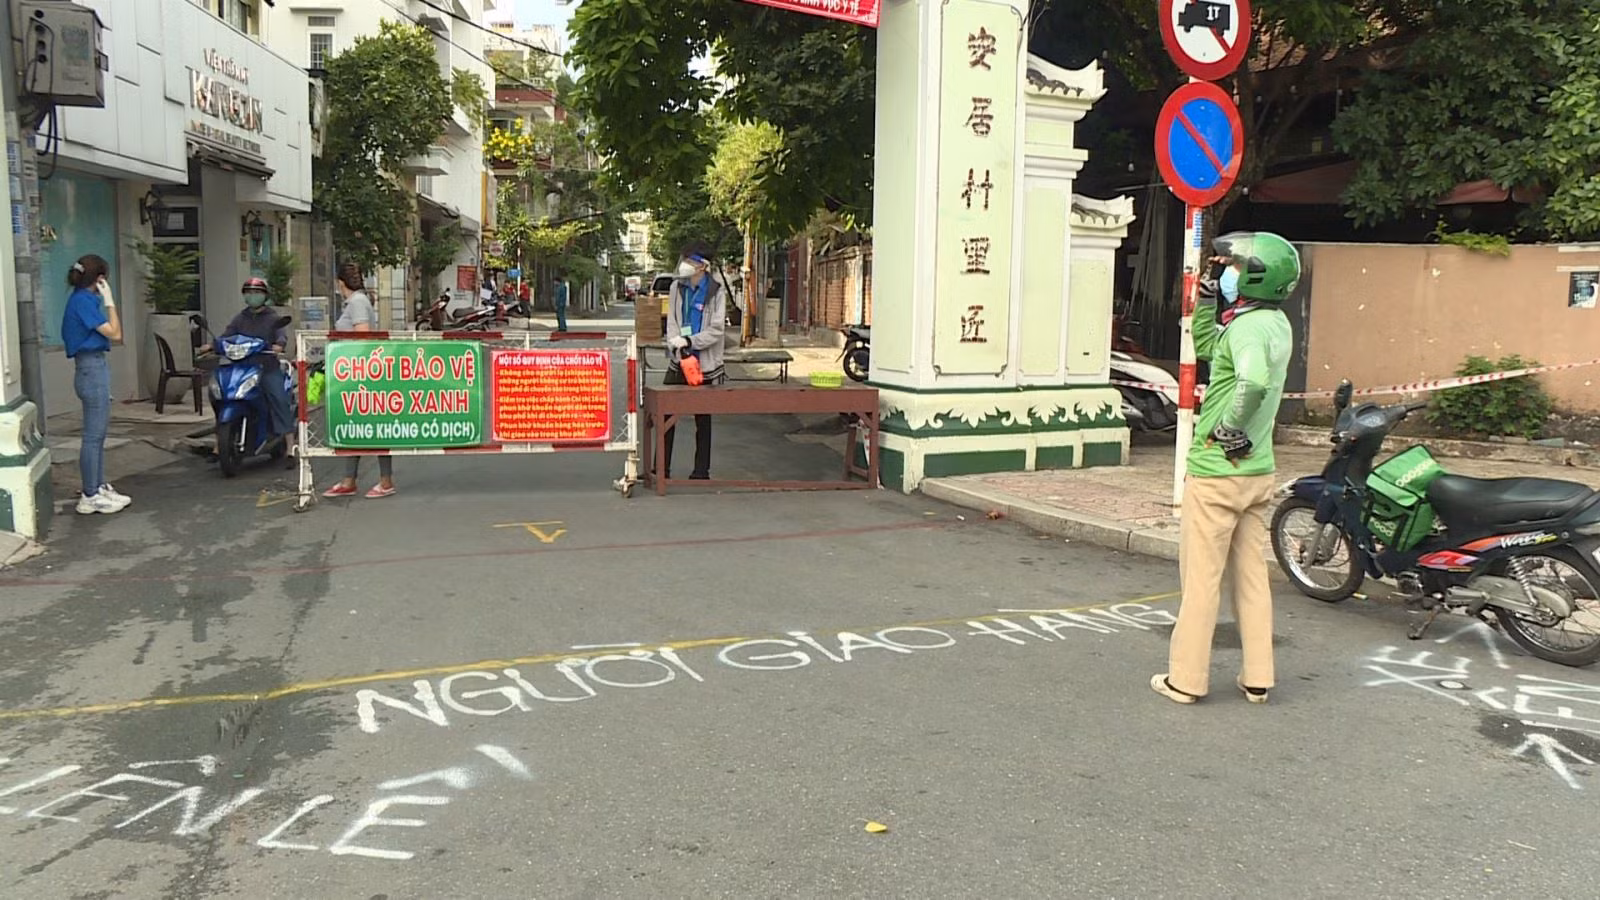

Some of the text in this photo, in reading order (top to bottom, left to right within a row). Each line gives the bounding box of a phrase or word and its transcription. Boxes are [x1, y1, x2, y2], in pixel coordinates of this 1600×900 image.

[1206, 5, 1221, 20] 1T
[333, 346, 476, 387] CHỐT BẢO VỆ
[341, 384, 470, 415] VÙNG XANH
[334, 418, 475, 442] (VÙNG KHÔNG CÓ DỊCH)
